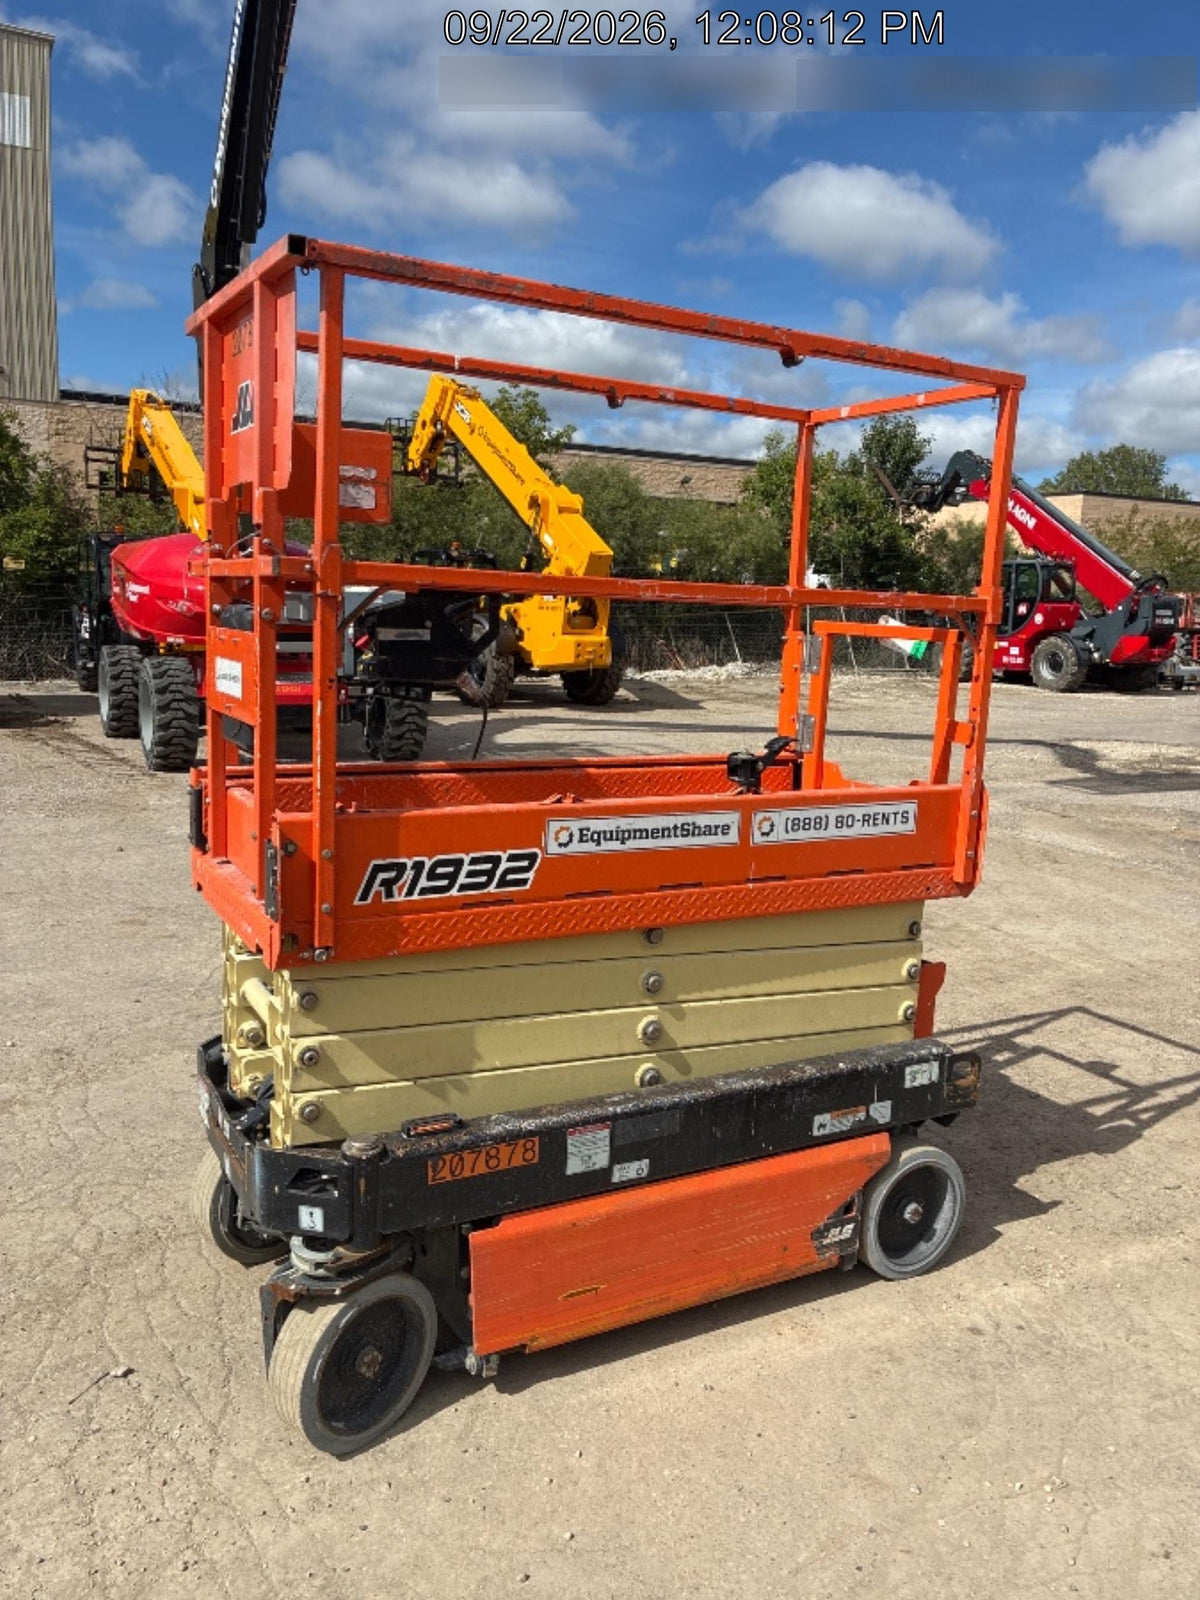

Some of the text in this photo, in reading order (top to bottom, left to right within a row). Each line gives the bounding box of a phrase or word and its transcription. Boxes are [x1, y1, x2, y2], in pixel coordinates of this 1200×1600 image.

[577, 821, 732, 846] EquipmentShare
[785, 810, 910, 834] (888) 80-RENTS
[354, 849, 541, 904] R1932
[429, 1139, 537, 1182] 207878
